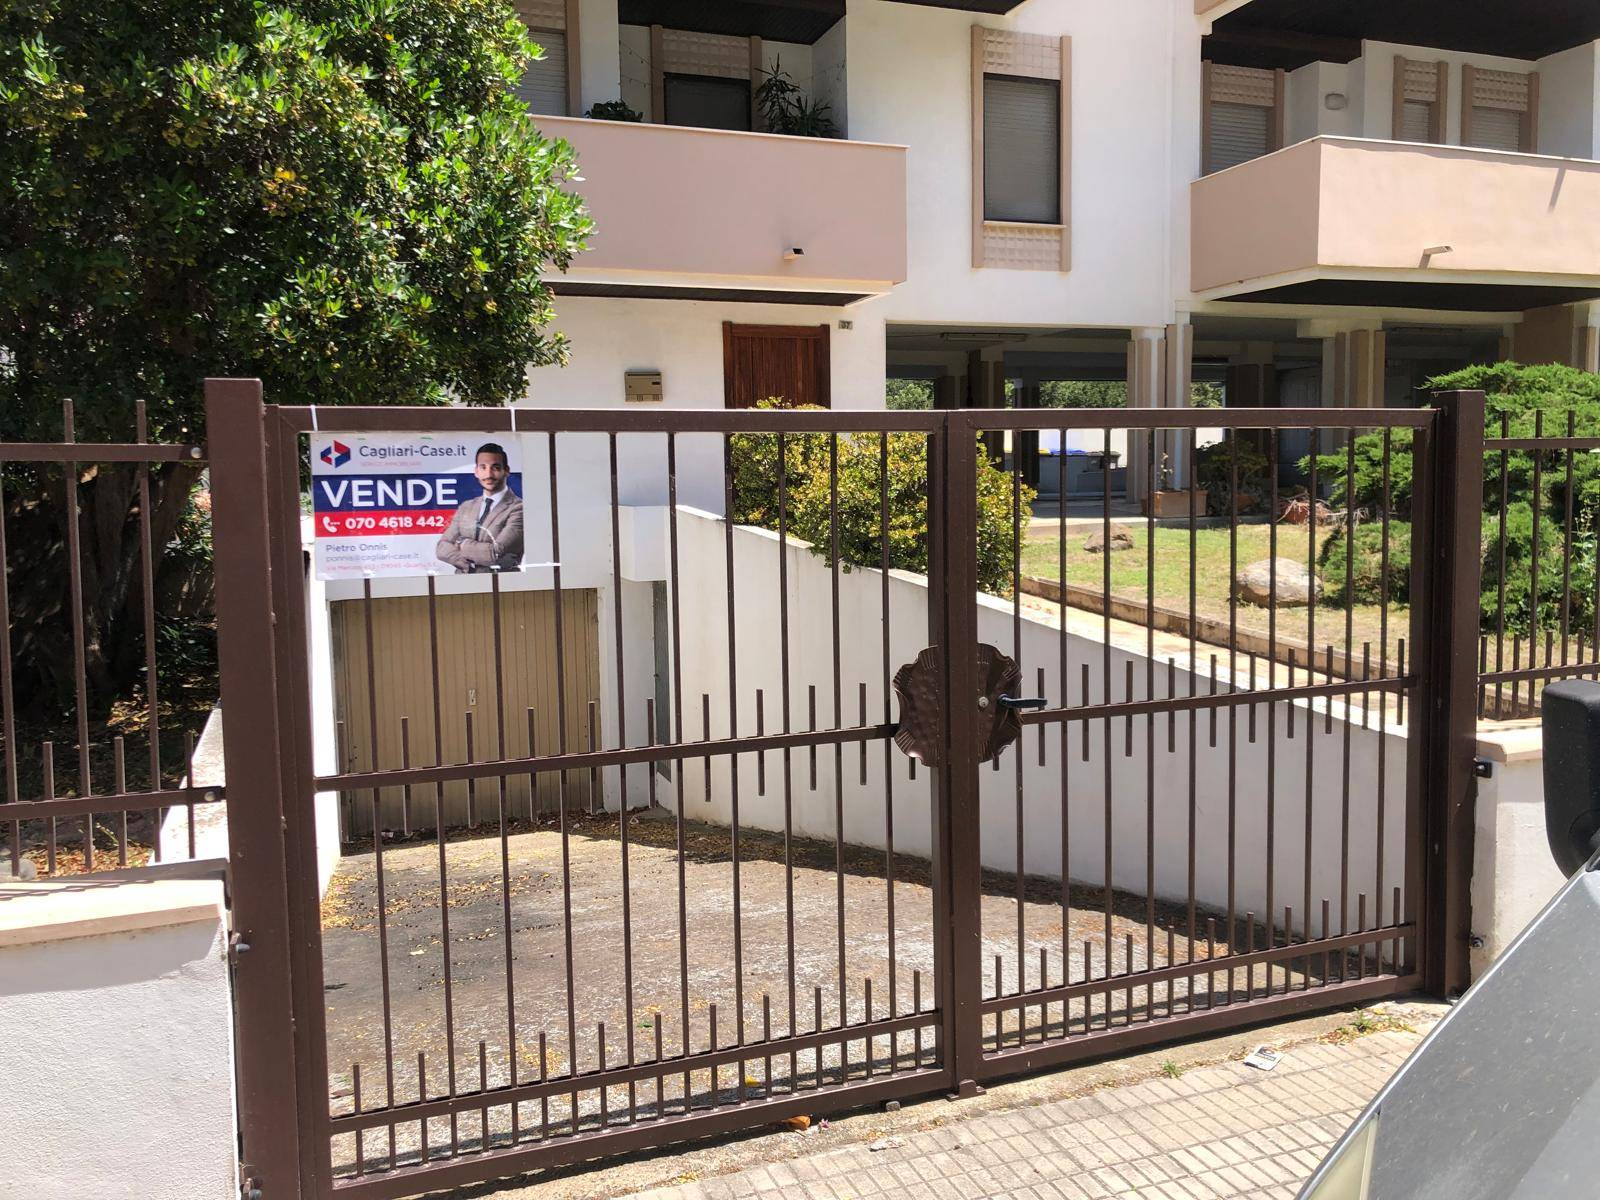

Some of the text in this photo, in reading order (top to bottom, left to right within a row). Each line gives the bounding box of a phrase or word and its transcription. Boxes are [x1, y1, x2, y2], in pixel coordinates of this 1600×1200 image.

[359, 445, 467, 460] Cagliari-Case.it
[321, 478, 458, 508] VENDE
[345, 516, 444, 529] 070 4618 442
[326, 542, 388, 553] Pietro Onnis
